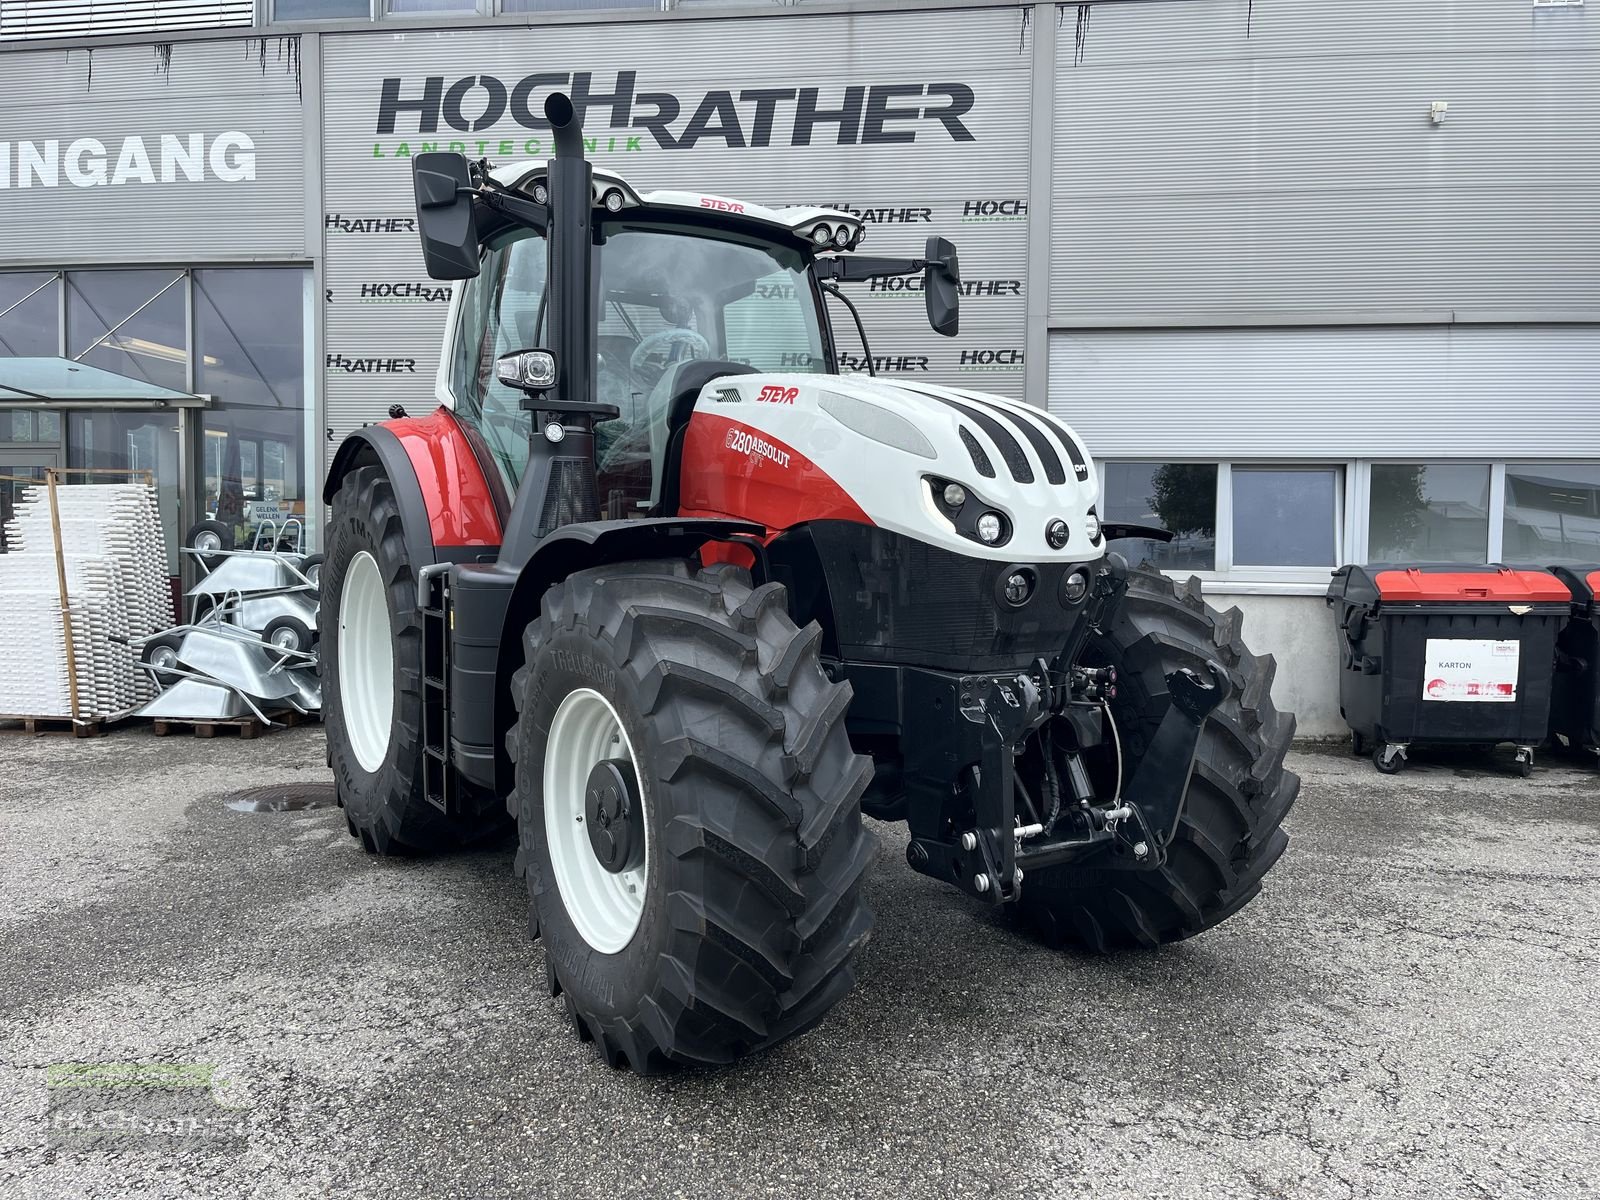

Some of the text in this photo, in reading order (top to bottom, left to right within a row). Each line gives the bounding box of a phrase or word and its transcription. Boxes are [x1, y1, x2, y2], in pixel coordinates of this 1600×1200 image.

[376, 70, 977, 150] HOCHRATHER
[0, 131, 256, 189] INGANG
[372, 136, 643, 158] LANDTECNIK
[700, 198, 744, 213] STEYR
[756, 386, 799, 404] STEYR
[752, 437, 790, 468] ABSOLUT
